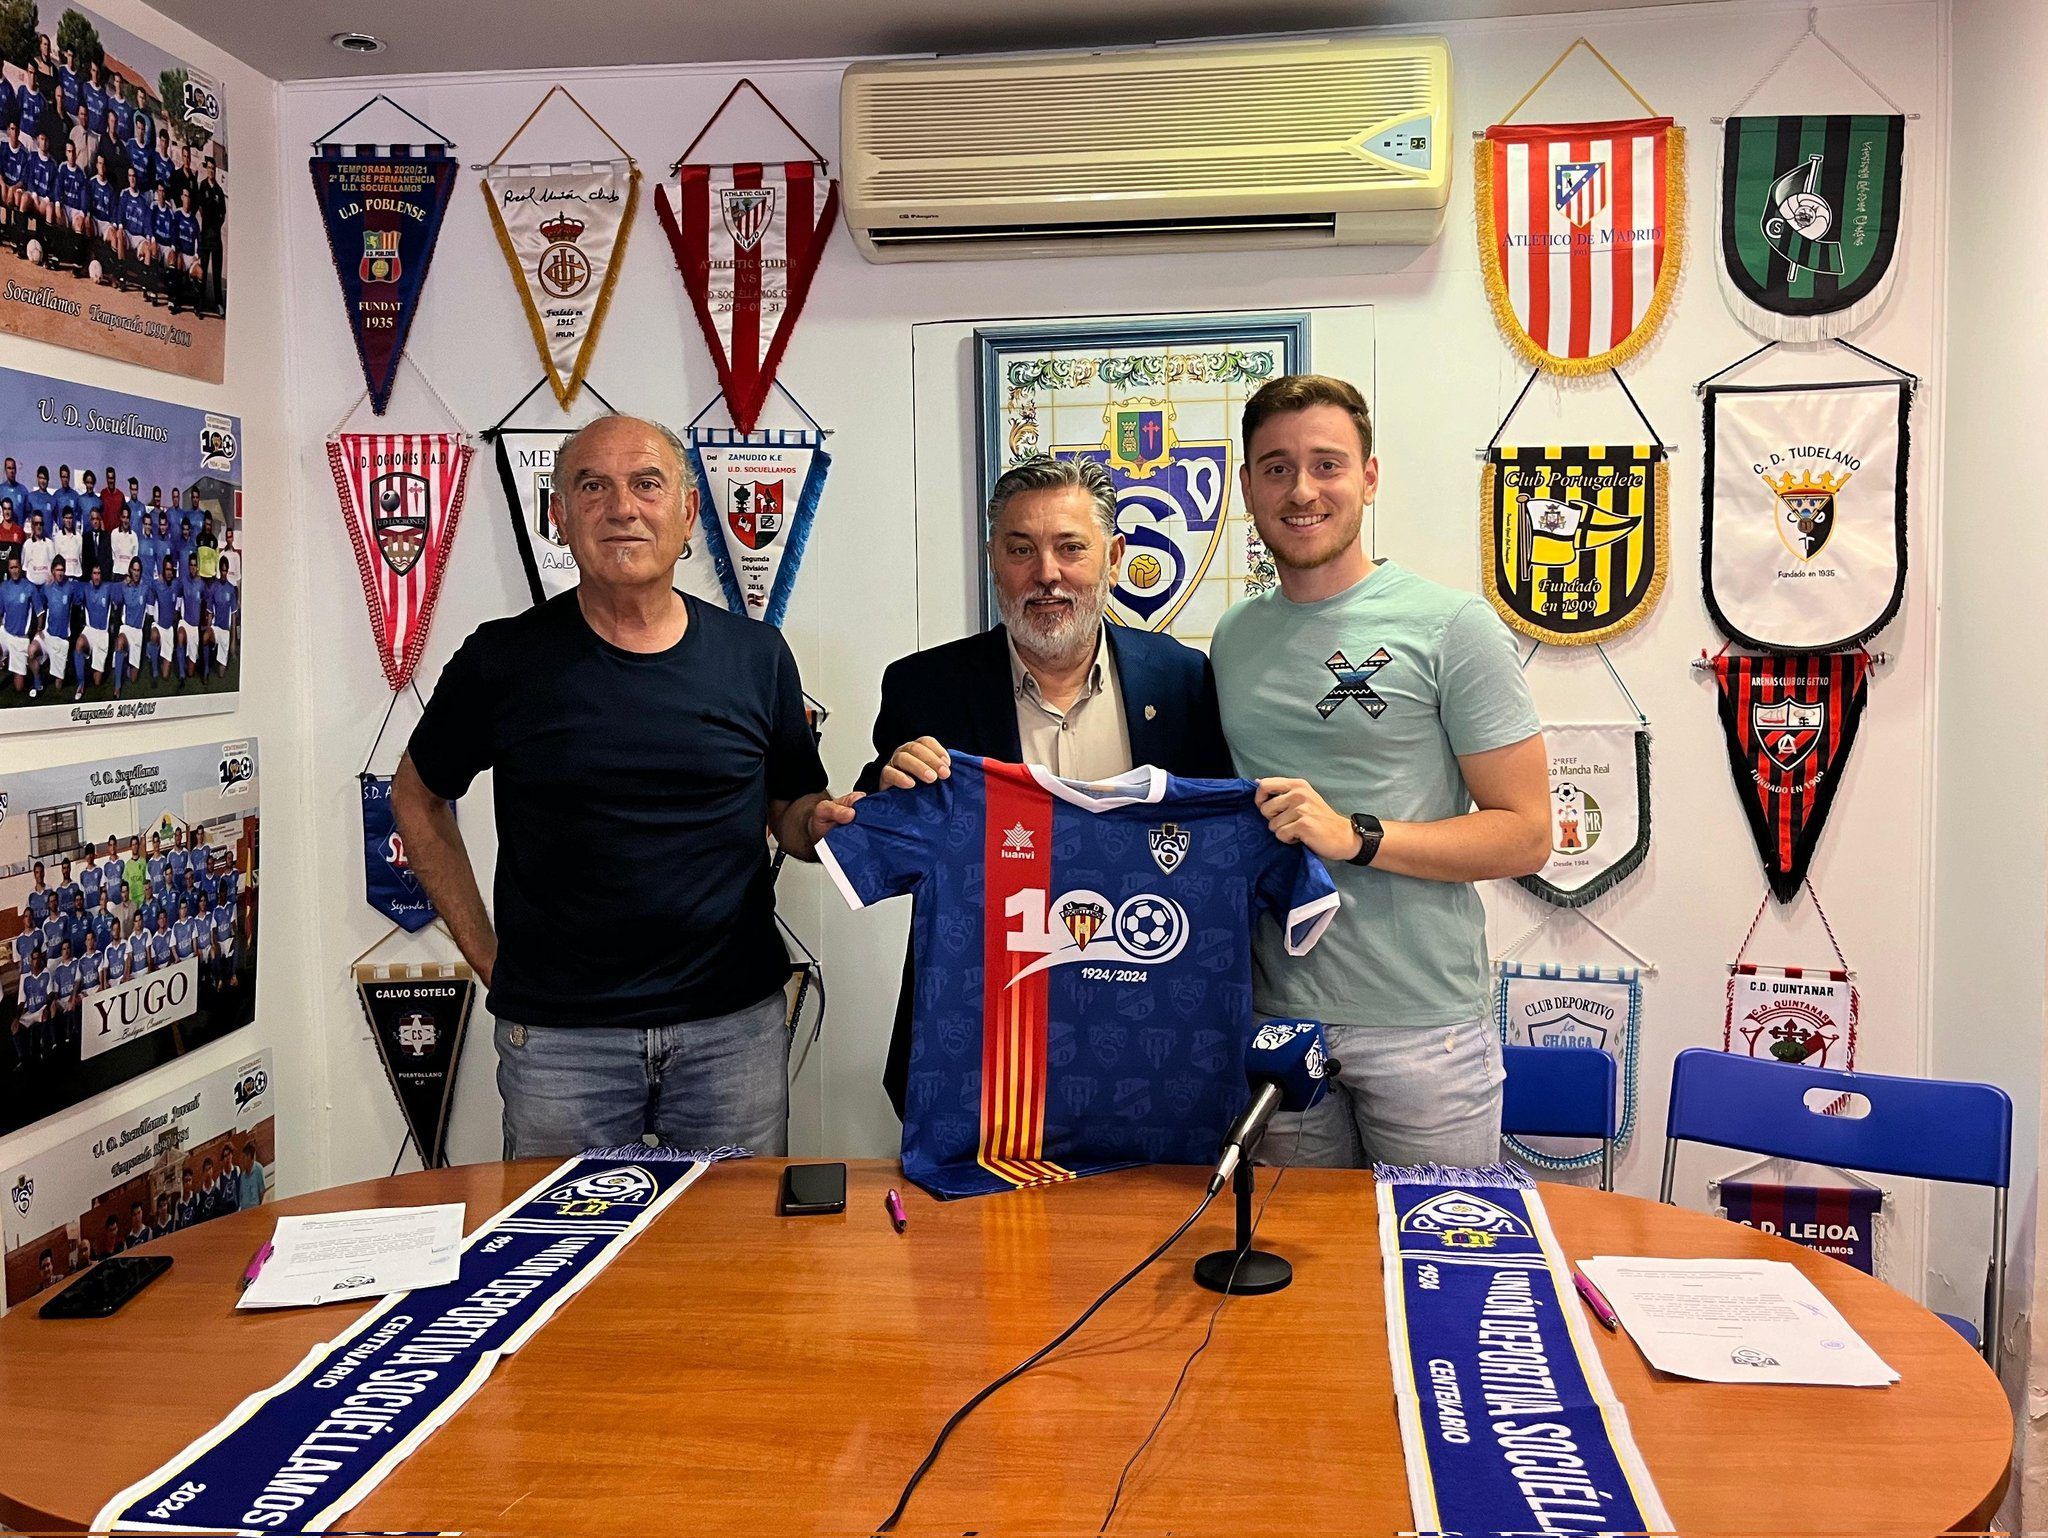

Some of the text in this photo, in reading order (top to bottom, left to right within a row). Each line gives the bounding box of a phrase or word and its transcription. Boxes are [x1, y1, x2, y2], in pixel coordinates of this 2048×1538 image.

[1410, 138, 1426, 150] 25
[337, 164, 428, 175] TEMPORADA 2020/21
[350, 174, 372, 183] FASE
[373, 175, 436, 184] PERMANENCIA
[341, 184, 422, 193] U.D. SOCUELLAMOS
[504, 186, 539, 208] Real
[338, 198, 427, 222] U.D. POBLENSE
[1577, 233, 1595, 245] DE
[1600, 227, 1662, 244] MADRID
[700, 260, 755, 270] ATHLETIC
[759, 259, 787, 269] CLUB
[740, 273, 758, 284] VS
[3, 279, 192, 347] Socuéllamos Temporada 1999/2000
[359, 301, 402, 311] FUNDAT
[366, 316, 394, 329] 1935
[85, 408, 168, 443] Socuéllamos
[1788, 446, 1861, 471] TUDELANO
[1505, 471, 1643, 490] Club Portugalete
[1778, 570, 1806, 578] Fundado
[1539, 577, 1602, 593] Fundado
[1541, 598, 1597, 612] en 1909
[1751, 676, 1829, 686] ARENAS CLUB DE GETXO
[1560, 765, 1591, 775] Mancha
[1593, 763, 1610, 774] Real
[1750, 769, 1824, 794] FUNDADO EN 1909
[390, 901, 425, 914] Segunda
[1081, 967, 1147, 983] 1924/2024
[375, 988, 456, 999] CALVO SOTELO
[1749, 981, 1834, 997] C.D. QUINTANAR
[93, 971, 188, 1037] YUGO
[1524, 996, 1615, 1021] CLUB DEPORTIVO
[1751, 1000, 1830, 1022] C.D. QUINTANAR
[1542, 1034, 1593, 1049] CHARCA
[1789, 1222, 1860, 1242] LEIOA
[480, 1234, 513, 1253] 1924
[504, 1236, 596, 1277] UNIÓN
[1417, 1263, 1440, 1291] 1924
[382, 1278, 544, 1365] DEPORTIVA
[312, 1315, 414, 1389] CENTENARIO
[1428, 1358, 1471, 1445] CENTENARIO
[1477, 1270, 1613, 1532] UNIÓN DEPORTIVA SOCUÉLL
[241, 1368, 440, 1528] SOCUÉLLAMOS
[147, 1480, 207, 1520] 2024
